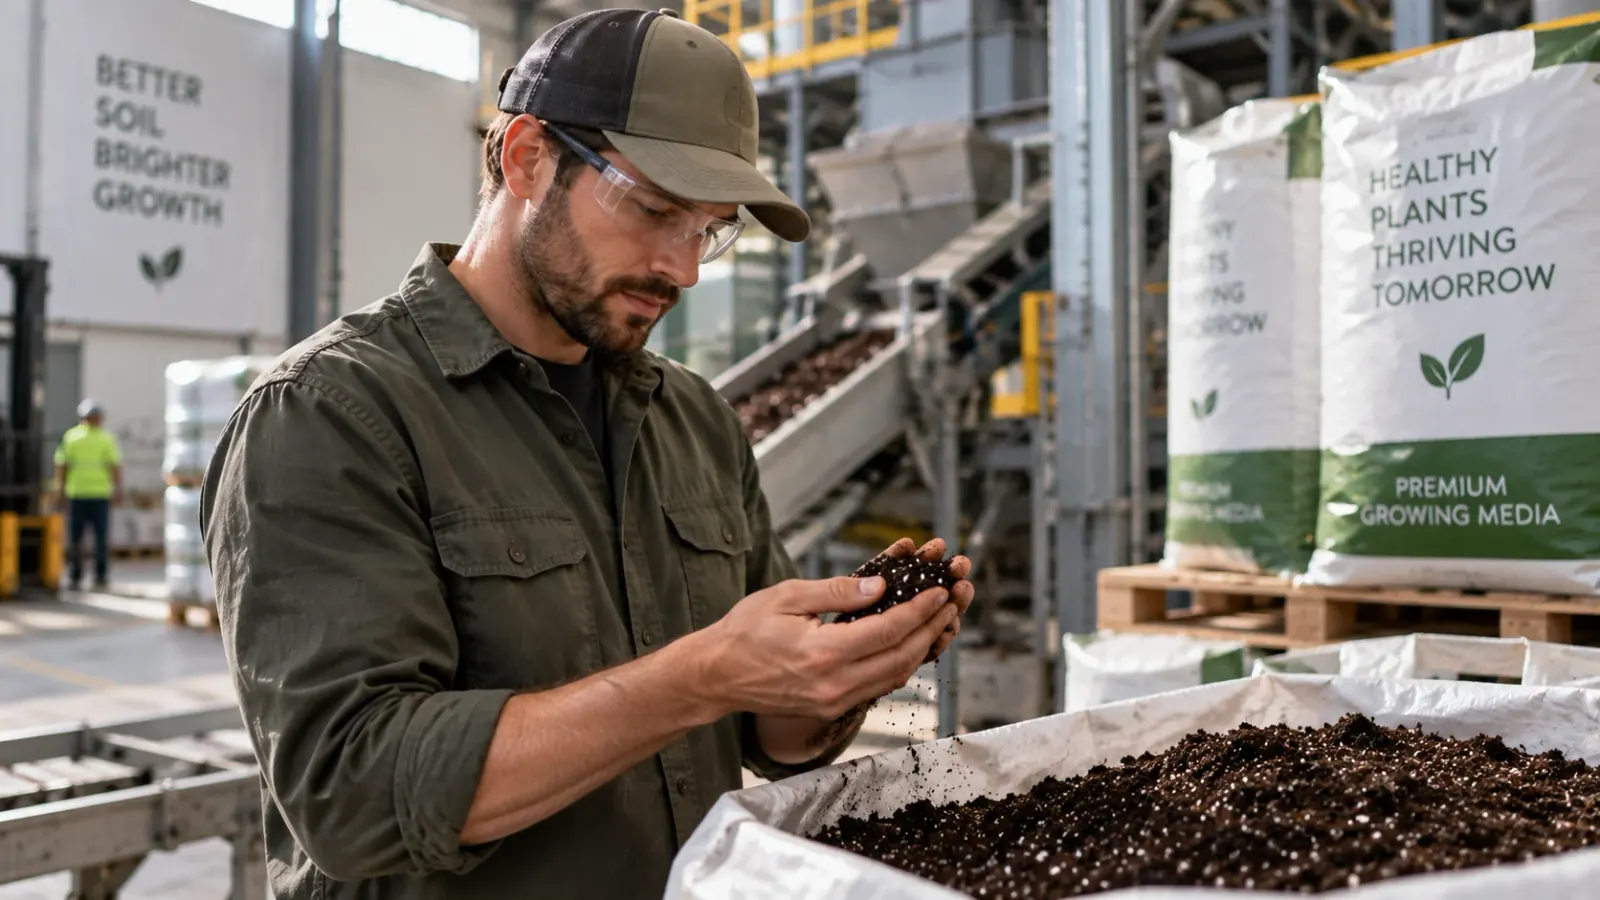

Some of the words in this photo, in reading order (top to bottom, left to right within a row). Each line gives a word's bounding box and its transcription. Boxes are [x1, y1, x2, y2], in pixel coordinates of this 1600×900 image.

[97, 54, 202, 107] BETTER
[95, 95, 165, 138] SOIL
[95, 138, 231, 189] BRIGHTER
[1370, 146, 1498, 194] HEALTHY
[93, 178, 223, 226] GROWTH
[1371, 189, 1488, 233] PLANTS
[1372, 226, 1517, 271] THRIVING
[1372, 262, 1556, 309] TOMORROW
[1395, 474, 1508, 498] PREMIUM
[1360, 503, 1471, 527] GROWING
[1477, 502, 1561, 526] MEDIA
